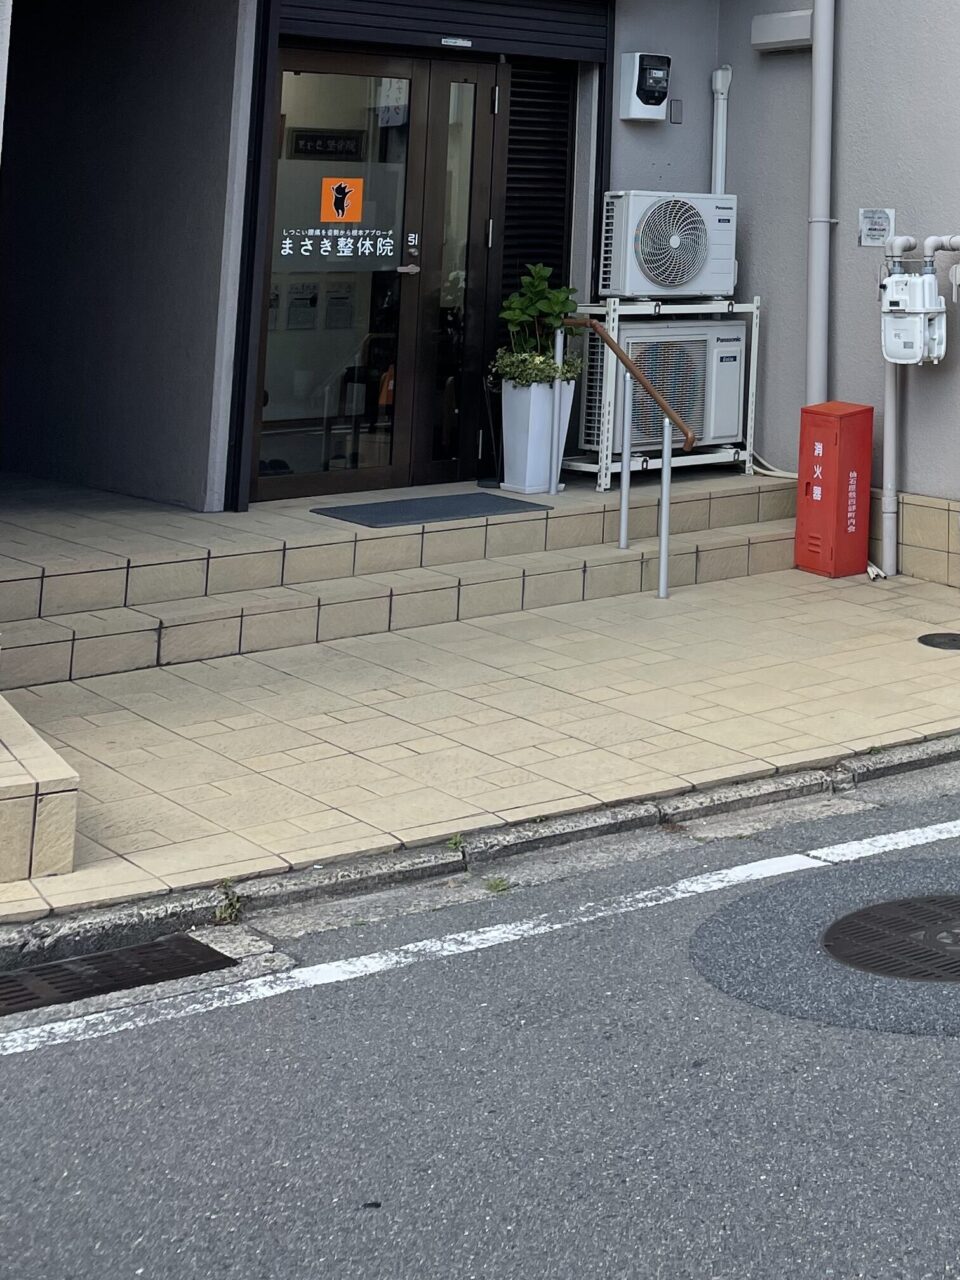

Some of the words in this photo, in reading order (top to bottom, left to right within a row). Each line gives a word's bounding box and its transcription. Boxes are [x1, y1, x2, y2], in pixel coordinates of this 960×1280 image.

[280, 237, 394, 256] まさき整体院
[812, 441, 823, 501] 消火器
